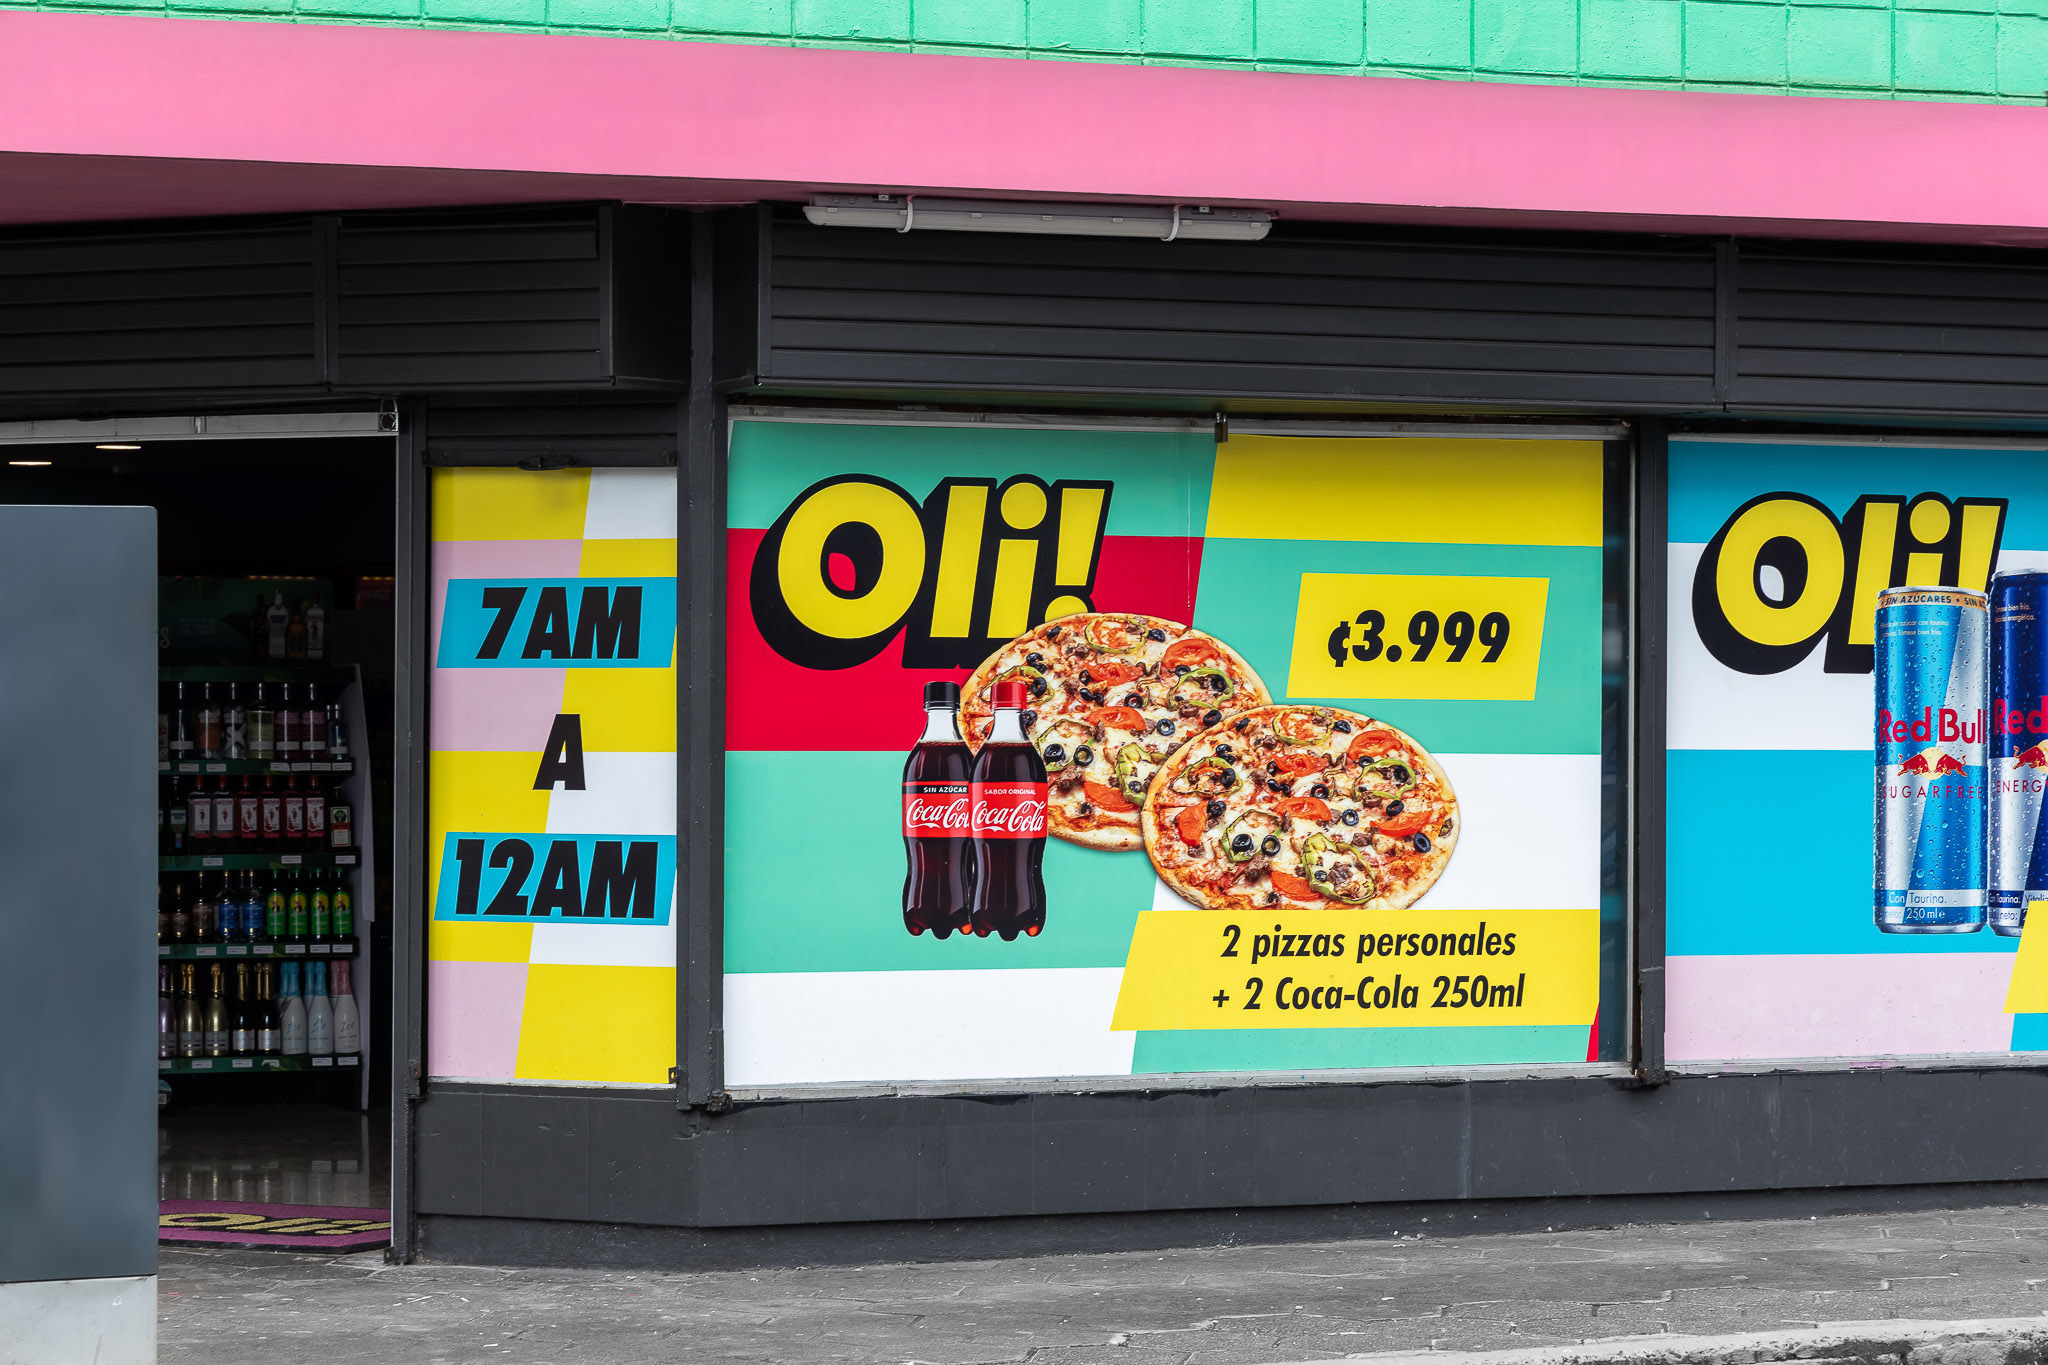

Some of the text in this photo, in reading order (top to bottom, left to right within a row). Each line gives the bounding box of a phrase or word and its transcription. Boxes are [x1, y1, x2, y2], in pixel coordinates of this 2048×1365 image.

[752, 474, 1113, 670] Oli!
[1885, 596, 1897, 605] SIN
[1900, 592, 1951, 603] AZÚCARES
[1964, 598, 1977, 607] SIN
[475, 586, 643, 659] 7AM
[1879, 706, 1986, 744] Red Bull
[1993, 695, 2048, 735] Red
[532, 713, 586, 791] A
[939, 785, 968, 793] AZÚCAR
[1996, 779, 2048, 793] ENERG
[971, 800, 1047, 832] Coca-Cola
[455, 838, 659, 919] 12AM
[1888, 892, 1947, 904] Con Taurina.
[1906, 907, 1925, 919] 250
[1220, 921, 1516, 964] 2 pizzas personales
[1212, 972, 1526, 1010] + 2 Coca-Cola 250ml
